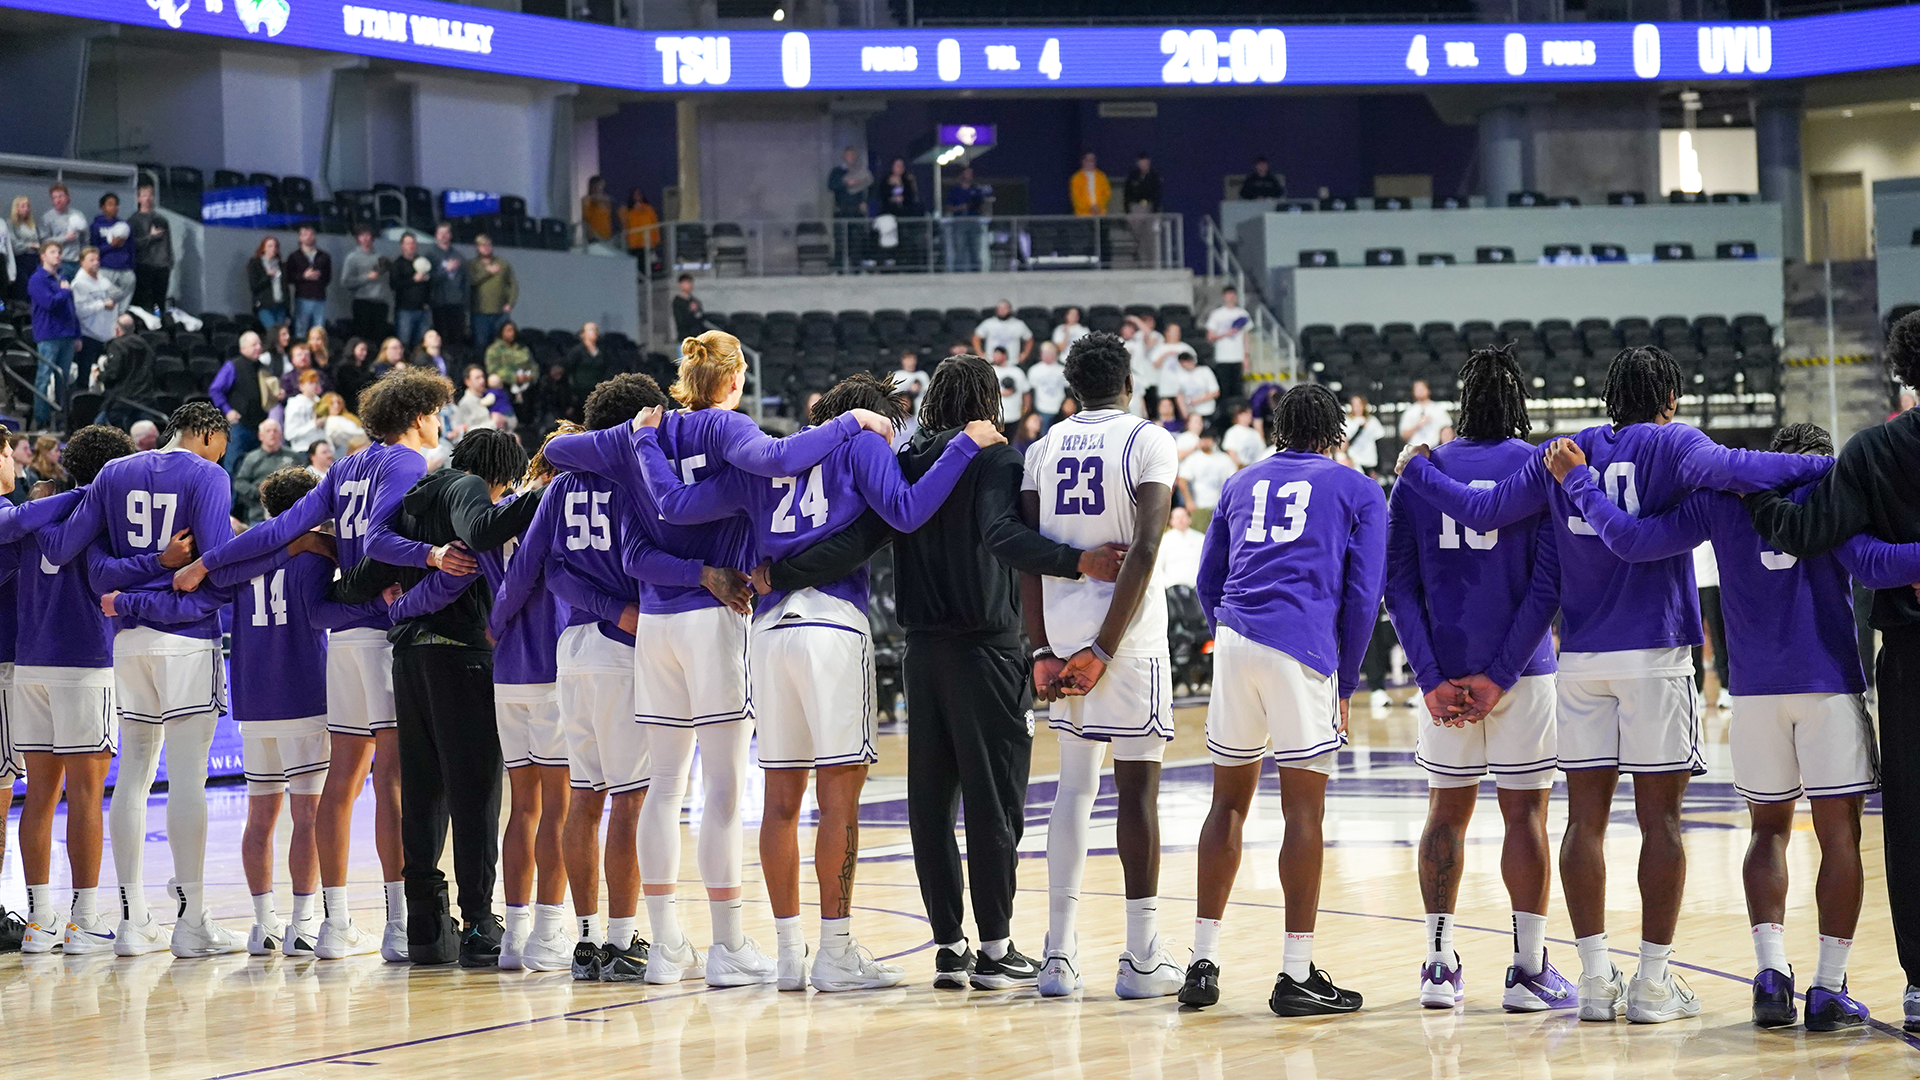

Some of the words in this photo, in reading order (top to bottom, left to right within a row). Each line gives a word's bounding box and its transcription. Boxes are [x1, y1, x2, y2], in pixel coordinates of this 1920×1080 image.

[343, 5, 407, 42] UTAH
[410, 15, 494, 53] VALLEY
[655, 37, 731, 84] TSU
[782, 32, 810, 87] 0
[938, 39, 960, 81] 0
[1039, 38, 1062, 80] 4
[1161, 29, 1286, 83] 20:00
[1406, 35, 1429, 76] 4
[1505, 33, 1527, 75] 0
[1633, 24, 1660, 78] 0
[1698, 27, 1771, 73] UVU
[339, 478, 370, 539] 22
[770, 464, 828, 533] 24
[1055, 456, 1105, 515] 23
[1245, 480, 1312, 543] 13
[126, 490, 178, 551] 97
[564, 490, 612, 550] 55
[251, 568, 288, 626] 14
